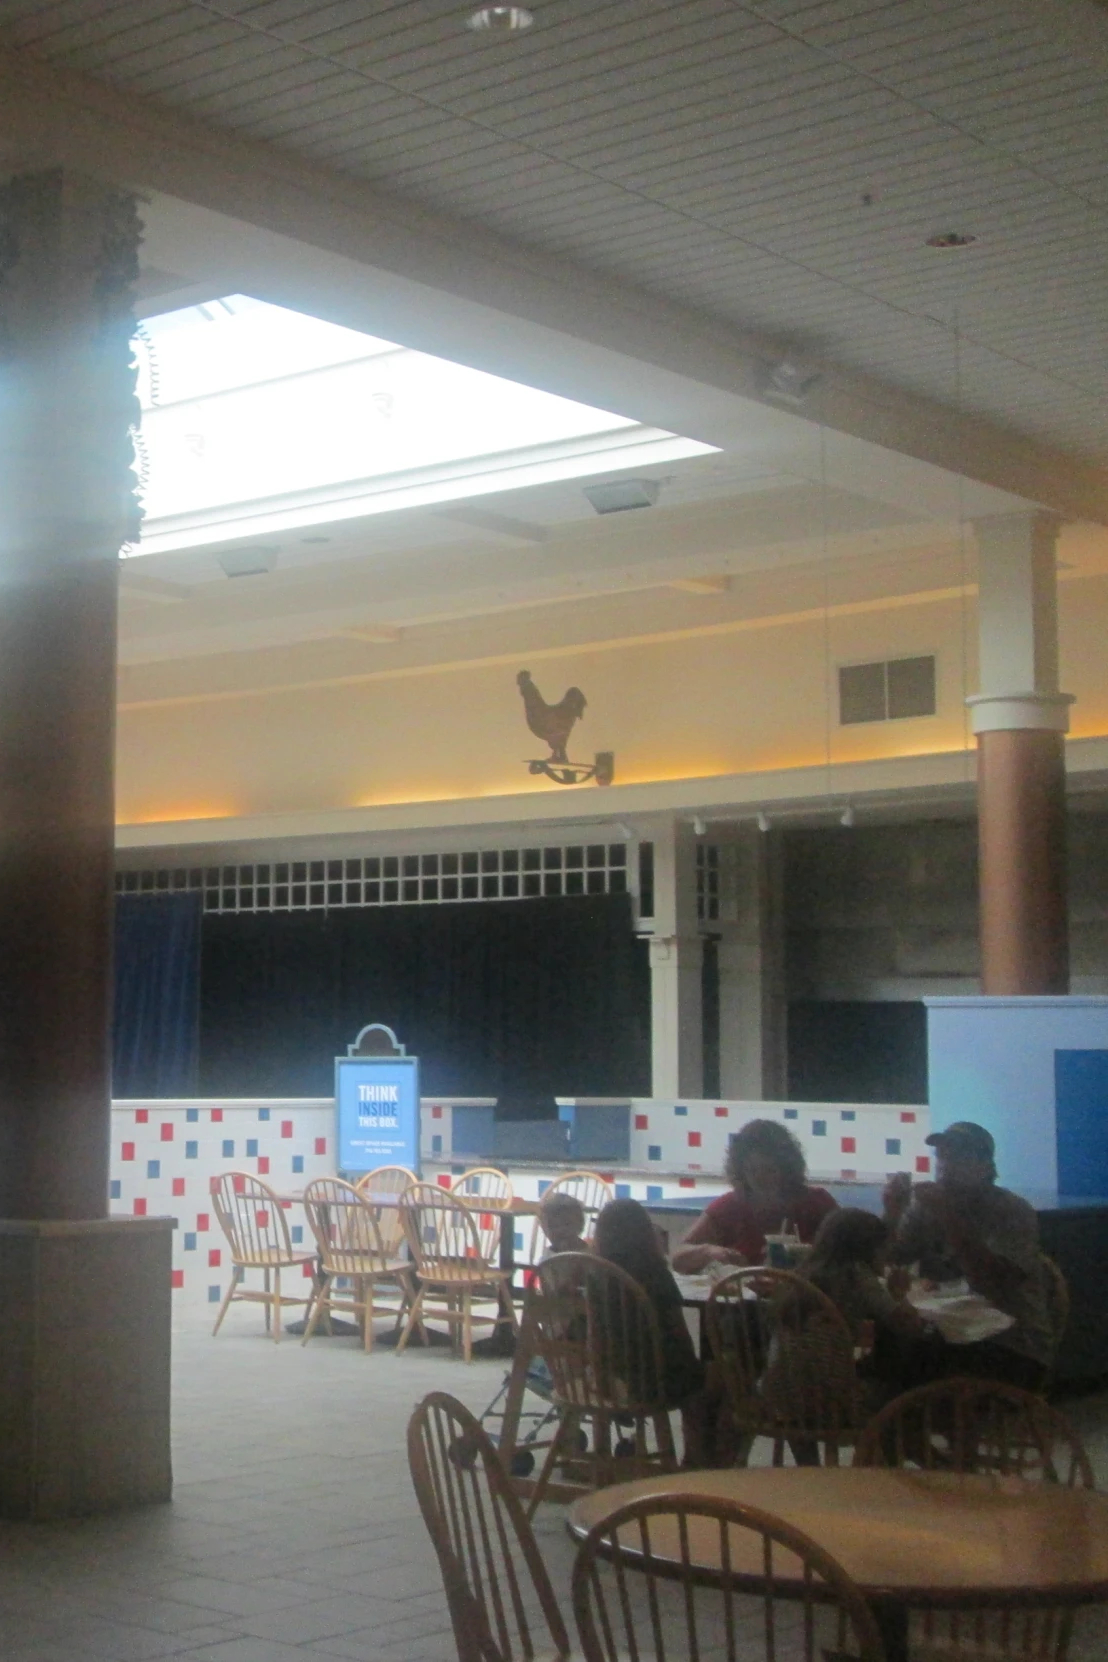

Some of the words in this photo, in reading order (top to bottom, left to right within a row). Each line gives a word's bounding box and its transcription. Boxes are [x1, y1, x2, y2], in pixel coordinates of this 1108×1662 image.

[358, 1085, 398, 1101] THINK
[358, 1101, 398, 1116] INSIDE
[359, 1116, 377, 1128] THIS
